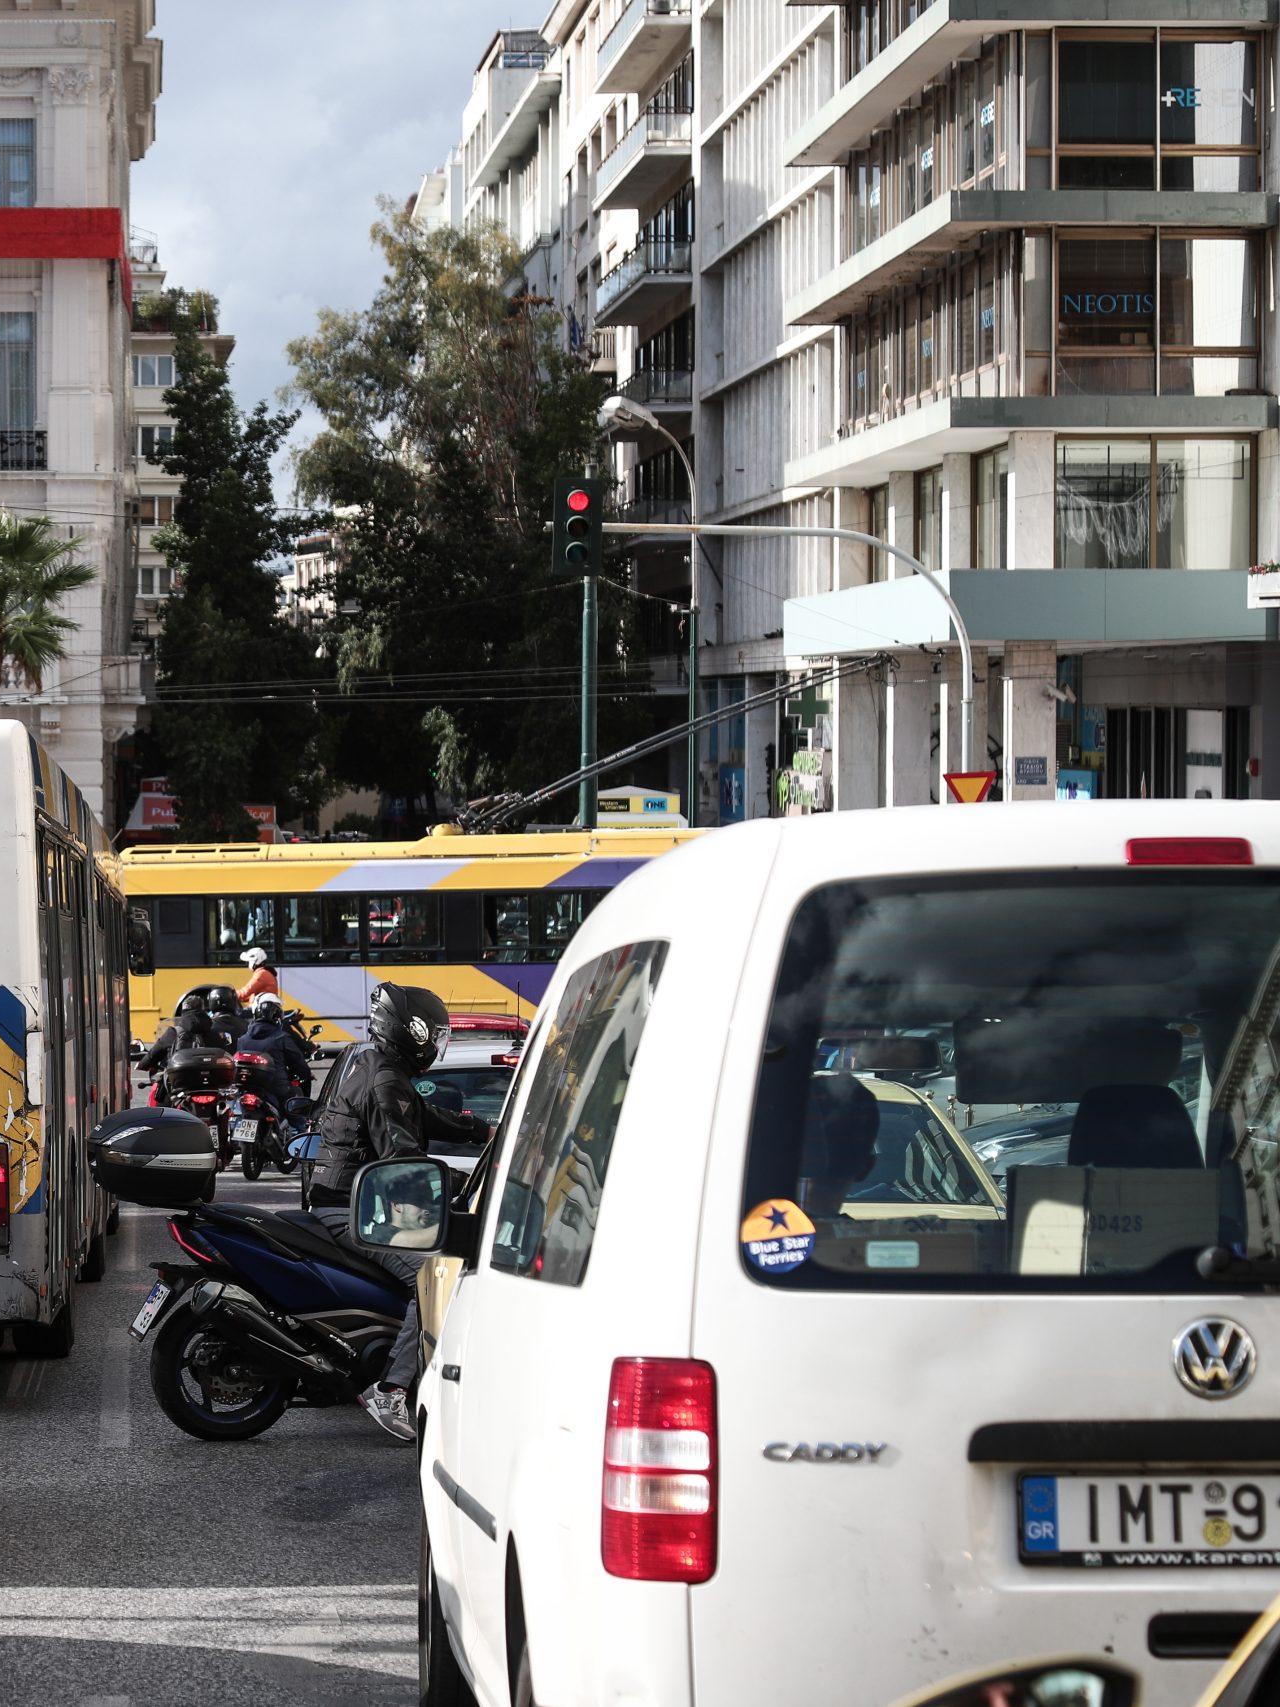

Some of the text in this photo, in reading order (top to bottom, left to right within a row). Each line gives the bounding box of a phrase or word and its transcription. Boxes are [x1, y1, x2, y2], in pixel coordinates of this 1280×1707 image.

[1062, 294, 1154, 314] NEOTIS
[750, 1237, 810, 1255] Blue Star
[759, 1252, 804, 1266] Ferries
[762, 1441, 887, 1464] CADDY
[1028, 1521, 1054, 1539] GR
